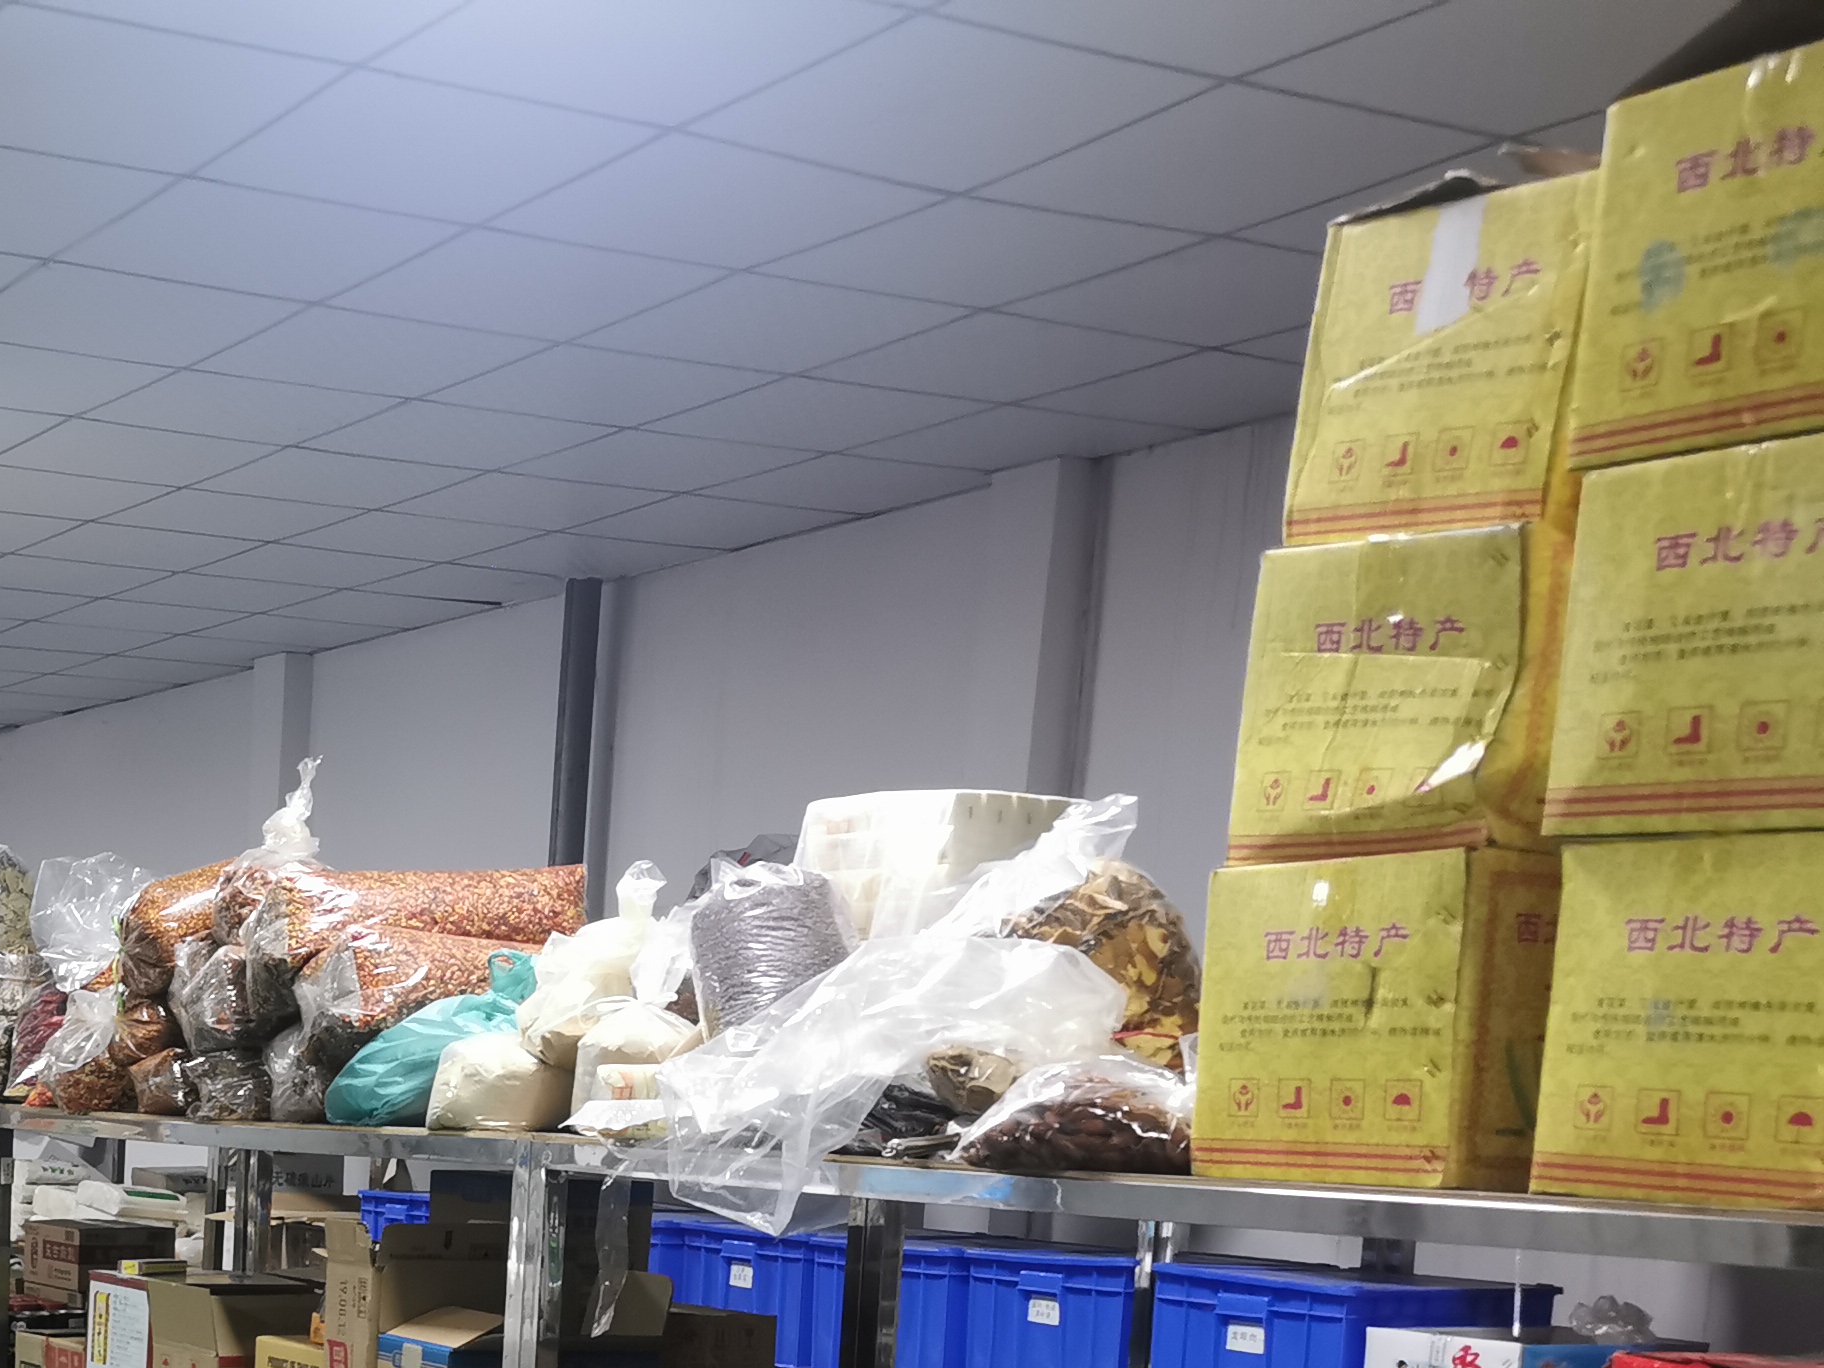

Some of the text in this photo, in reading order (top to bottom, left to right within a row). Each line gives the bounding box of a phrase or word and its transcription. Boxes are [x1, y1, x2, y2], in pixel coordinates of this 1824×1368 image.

[1675, 123, 1824, 193] 西北特
[1387, 259, 1542, 315] 西特产
[1314, 615, 1466, 653] 西北特产
[1263, 922, 1410, 962] 西北特产
[1624, 914, 1821, 955] 西北特产
